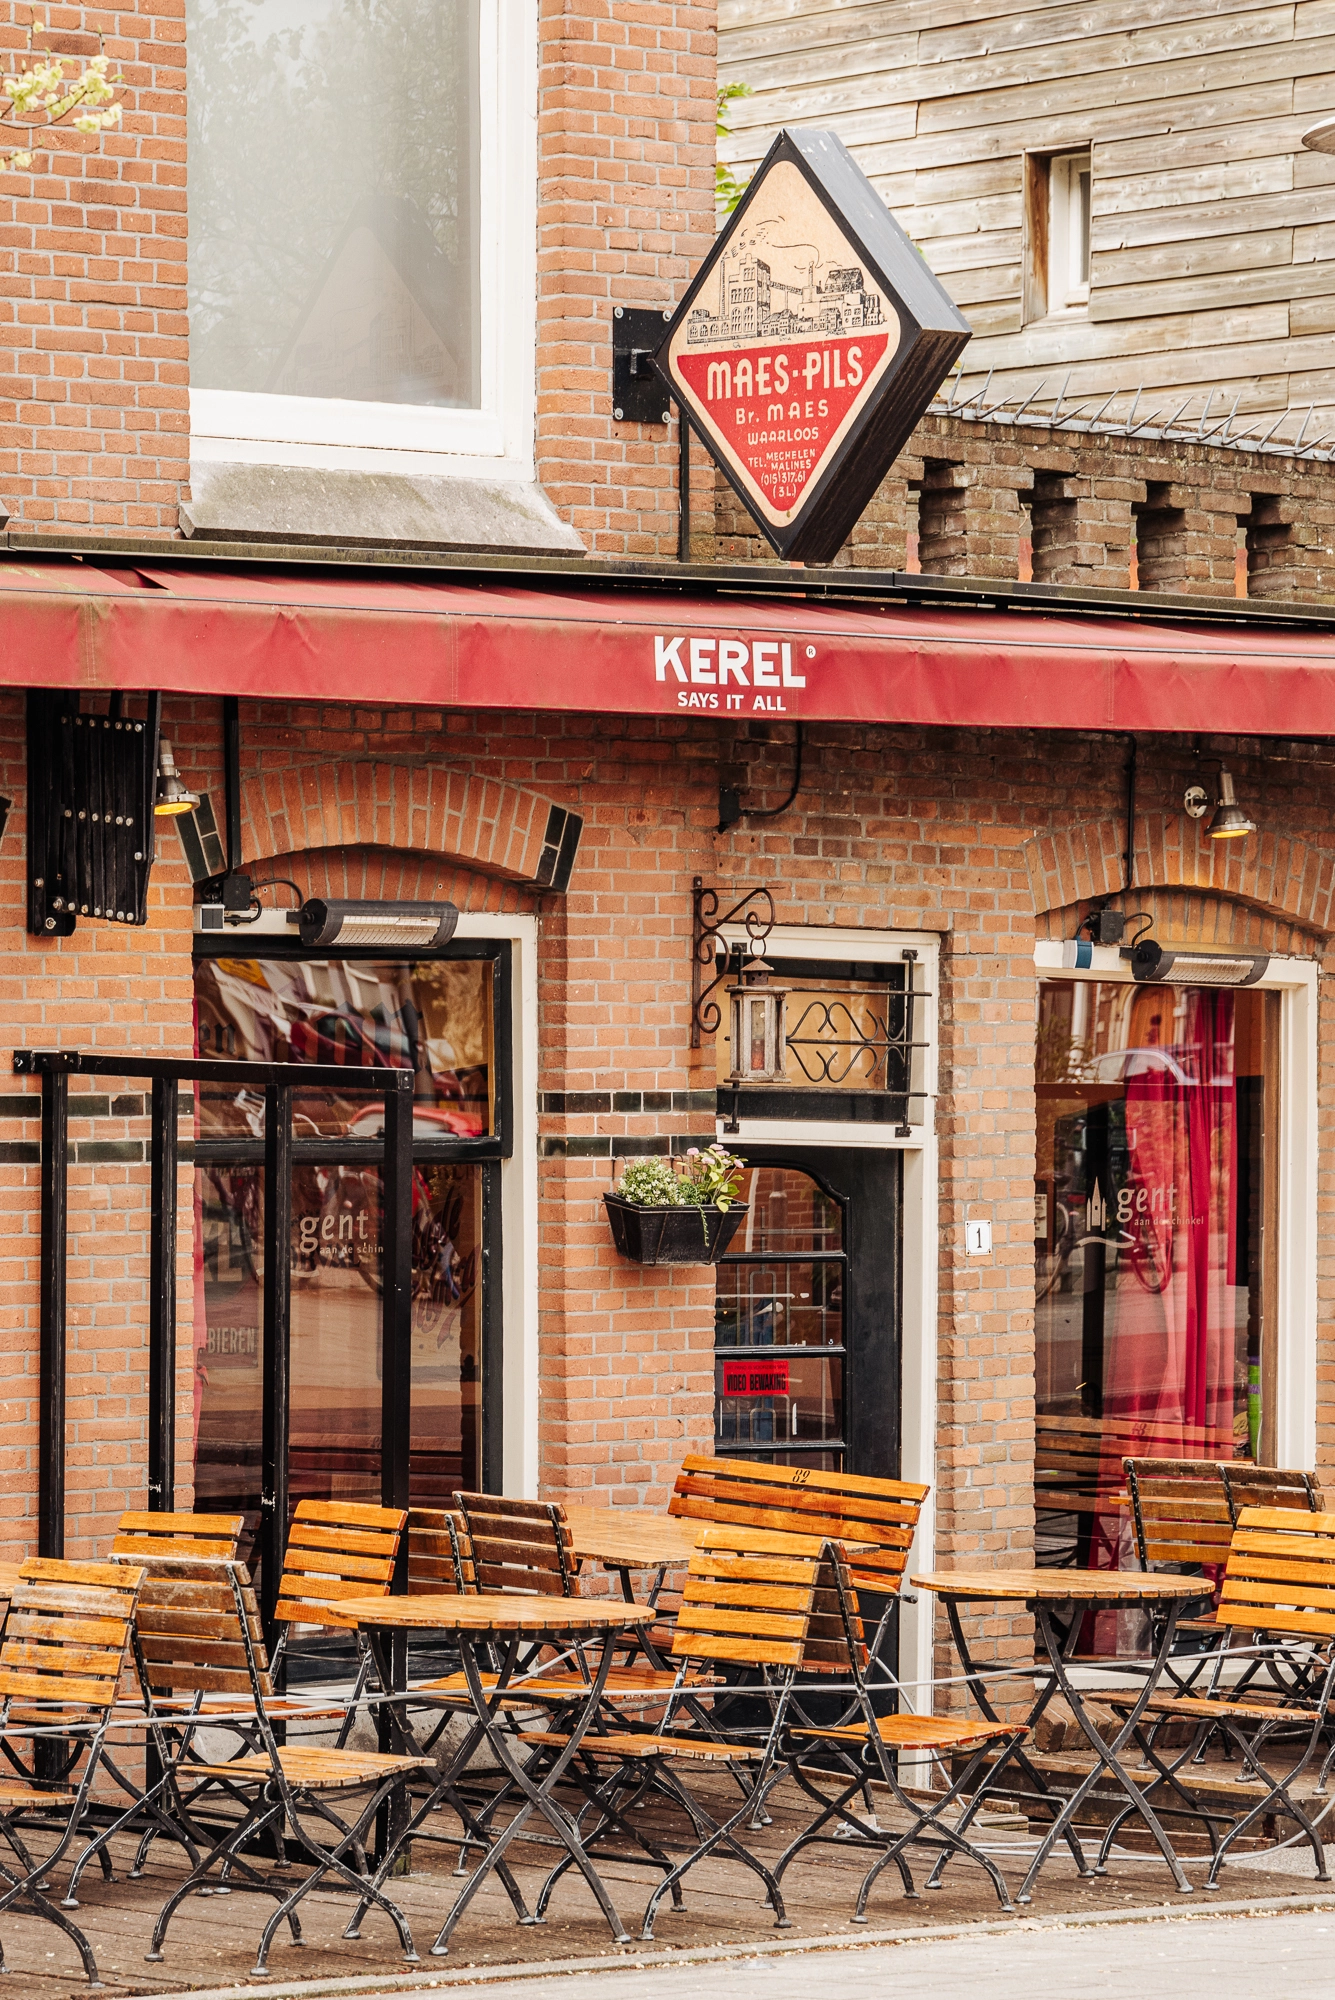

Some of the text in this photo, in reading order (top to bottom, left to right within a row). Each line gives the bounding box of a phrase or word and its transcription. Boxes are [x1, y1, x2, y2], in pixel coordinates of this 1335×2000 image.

[735, 399, 829, 425] Br. MAES
[747, 426, 819, 446] WAARLOOS
[747, 448, 816, 468] TEL. MECHELEN
[771, 458, 812, 471] MALINES
[677, 691, 787, 711] SAYS IT ALL
[1116, 1182, 1178, 1223] gent
[299, 1209, 369, 1253] gent
[976, 1227, 983, 1249] 1
[207, 1326, 256, 1354] BIEREN
[726, 1373, 786, 1392] VIDEO BEWAKING
[792, 1469, 811, 1484] 82
